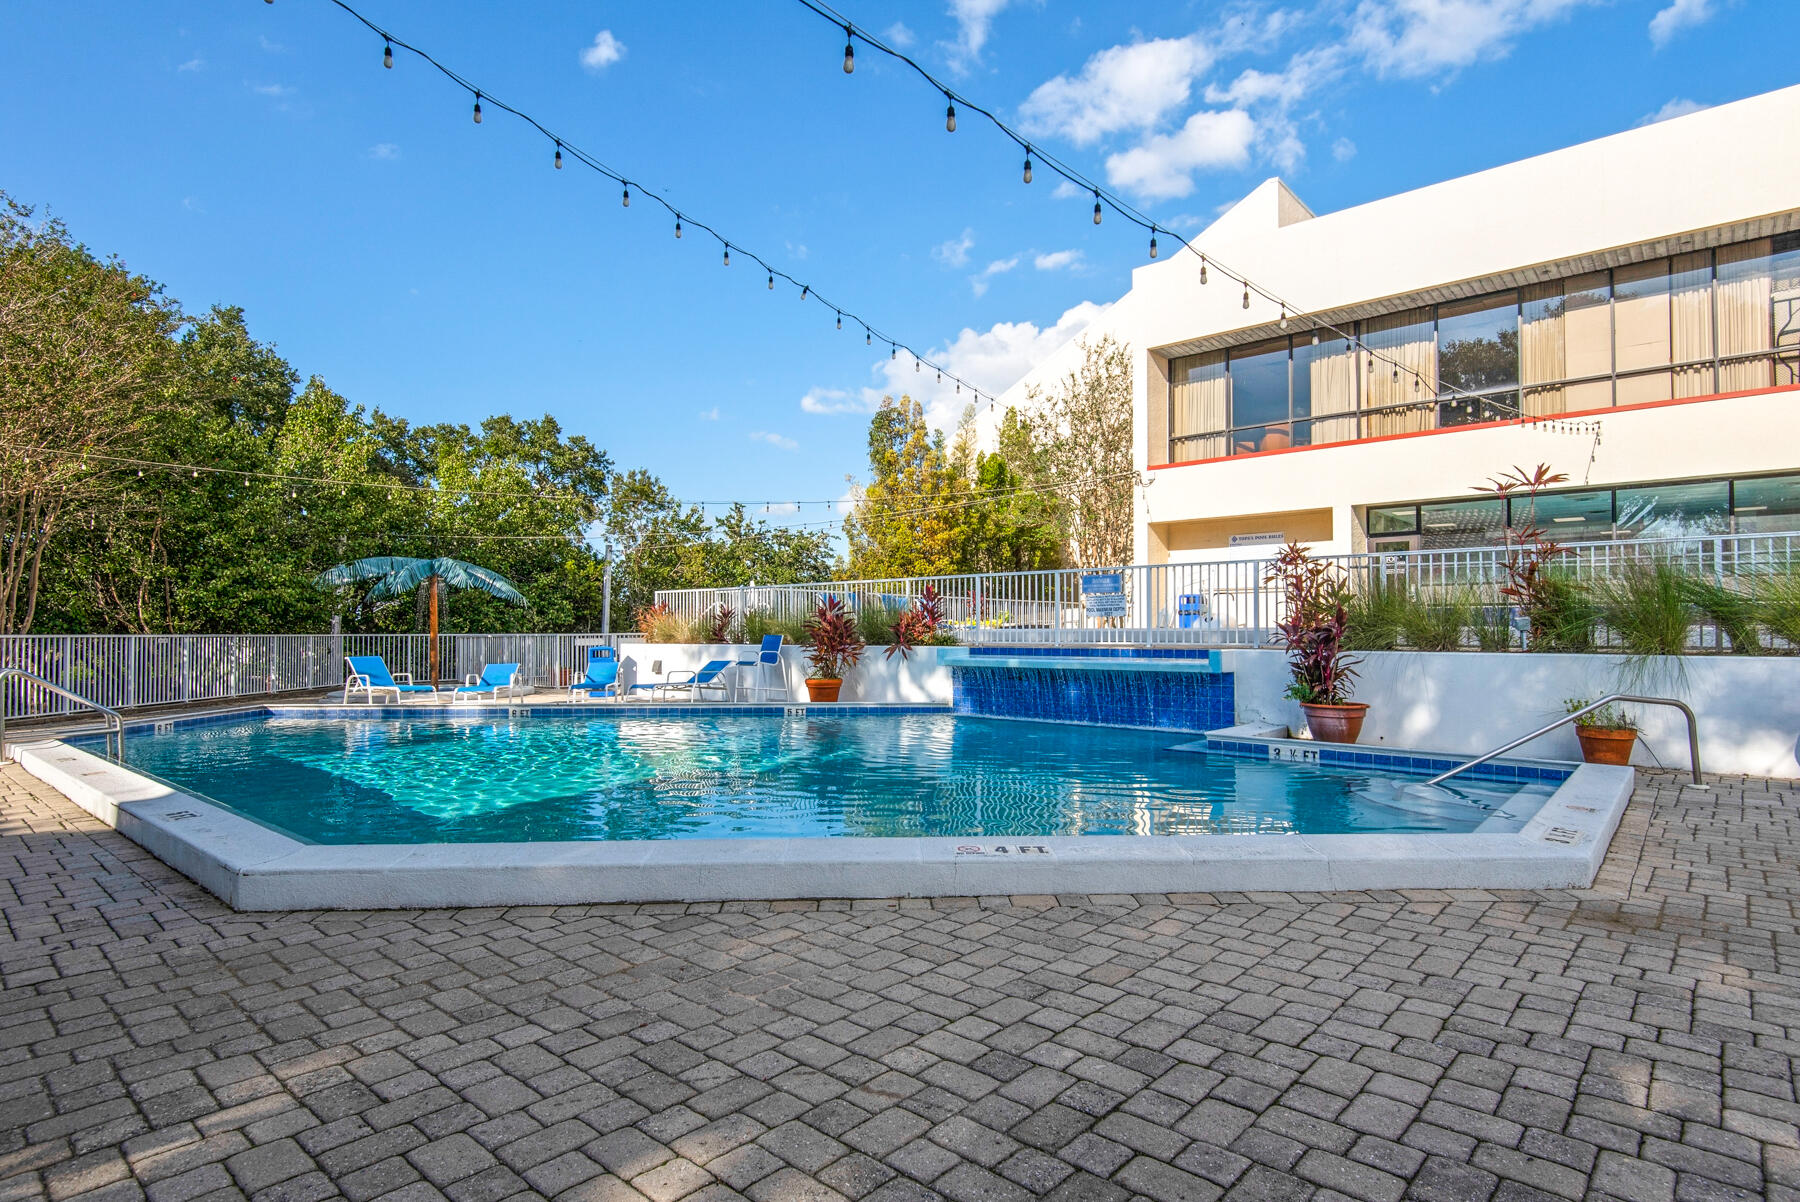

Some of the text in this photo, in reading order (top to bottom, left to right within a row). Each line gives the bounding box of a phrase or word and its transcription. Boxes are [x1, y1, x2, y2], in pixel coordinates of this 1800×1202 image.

[795, 708, 805, 717] FT
[1303, 750, 1318, 759] FT
[994, 846, 1009, 854] 4
